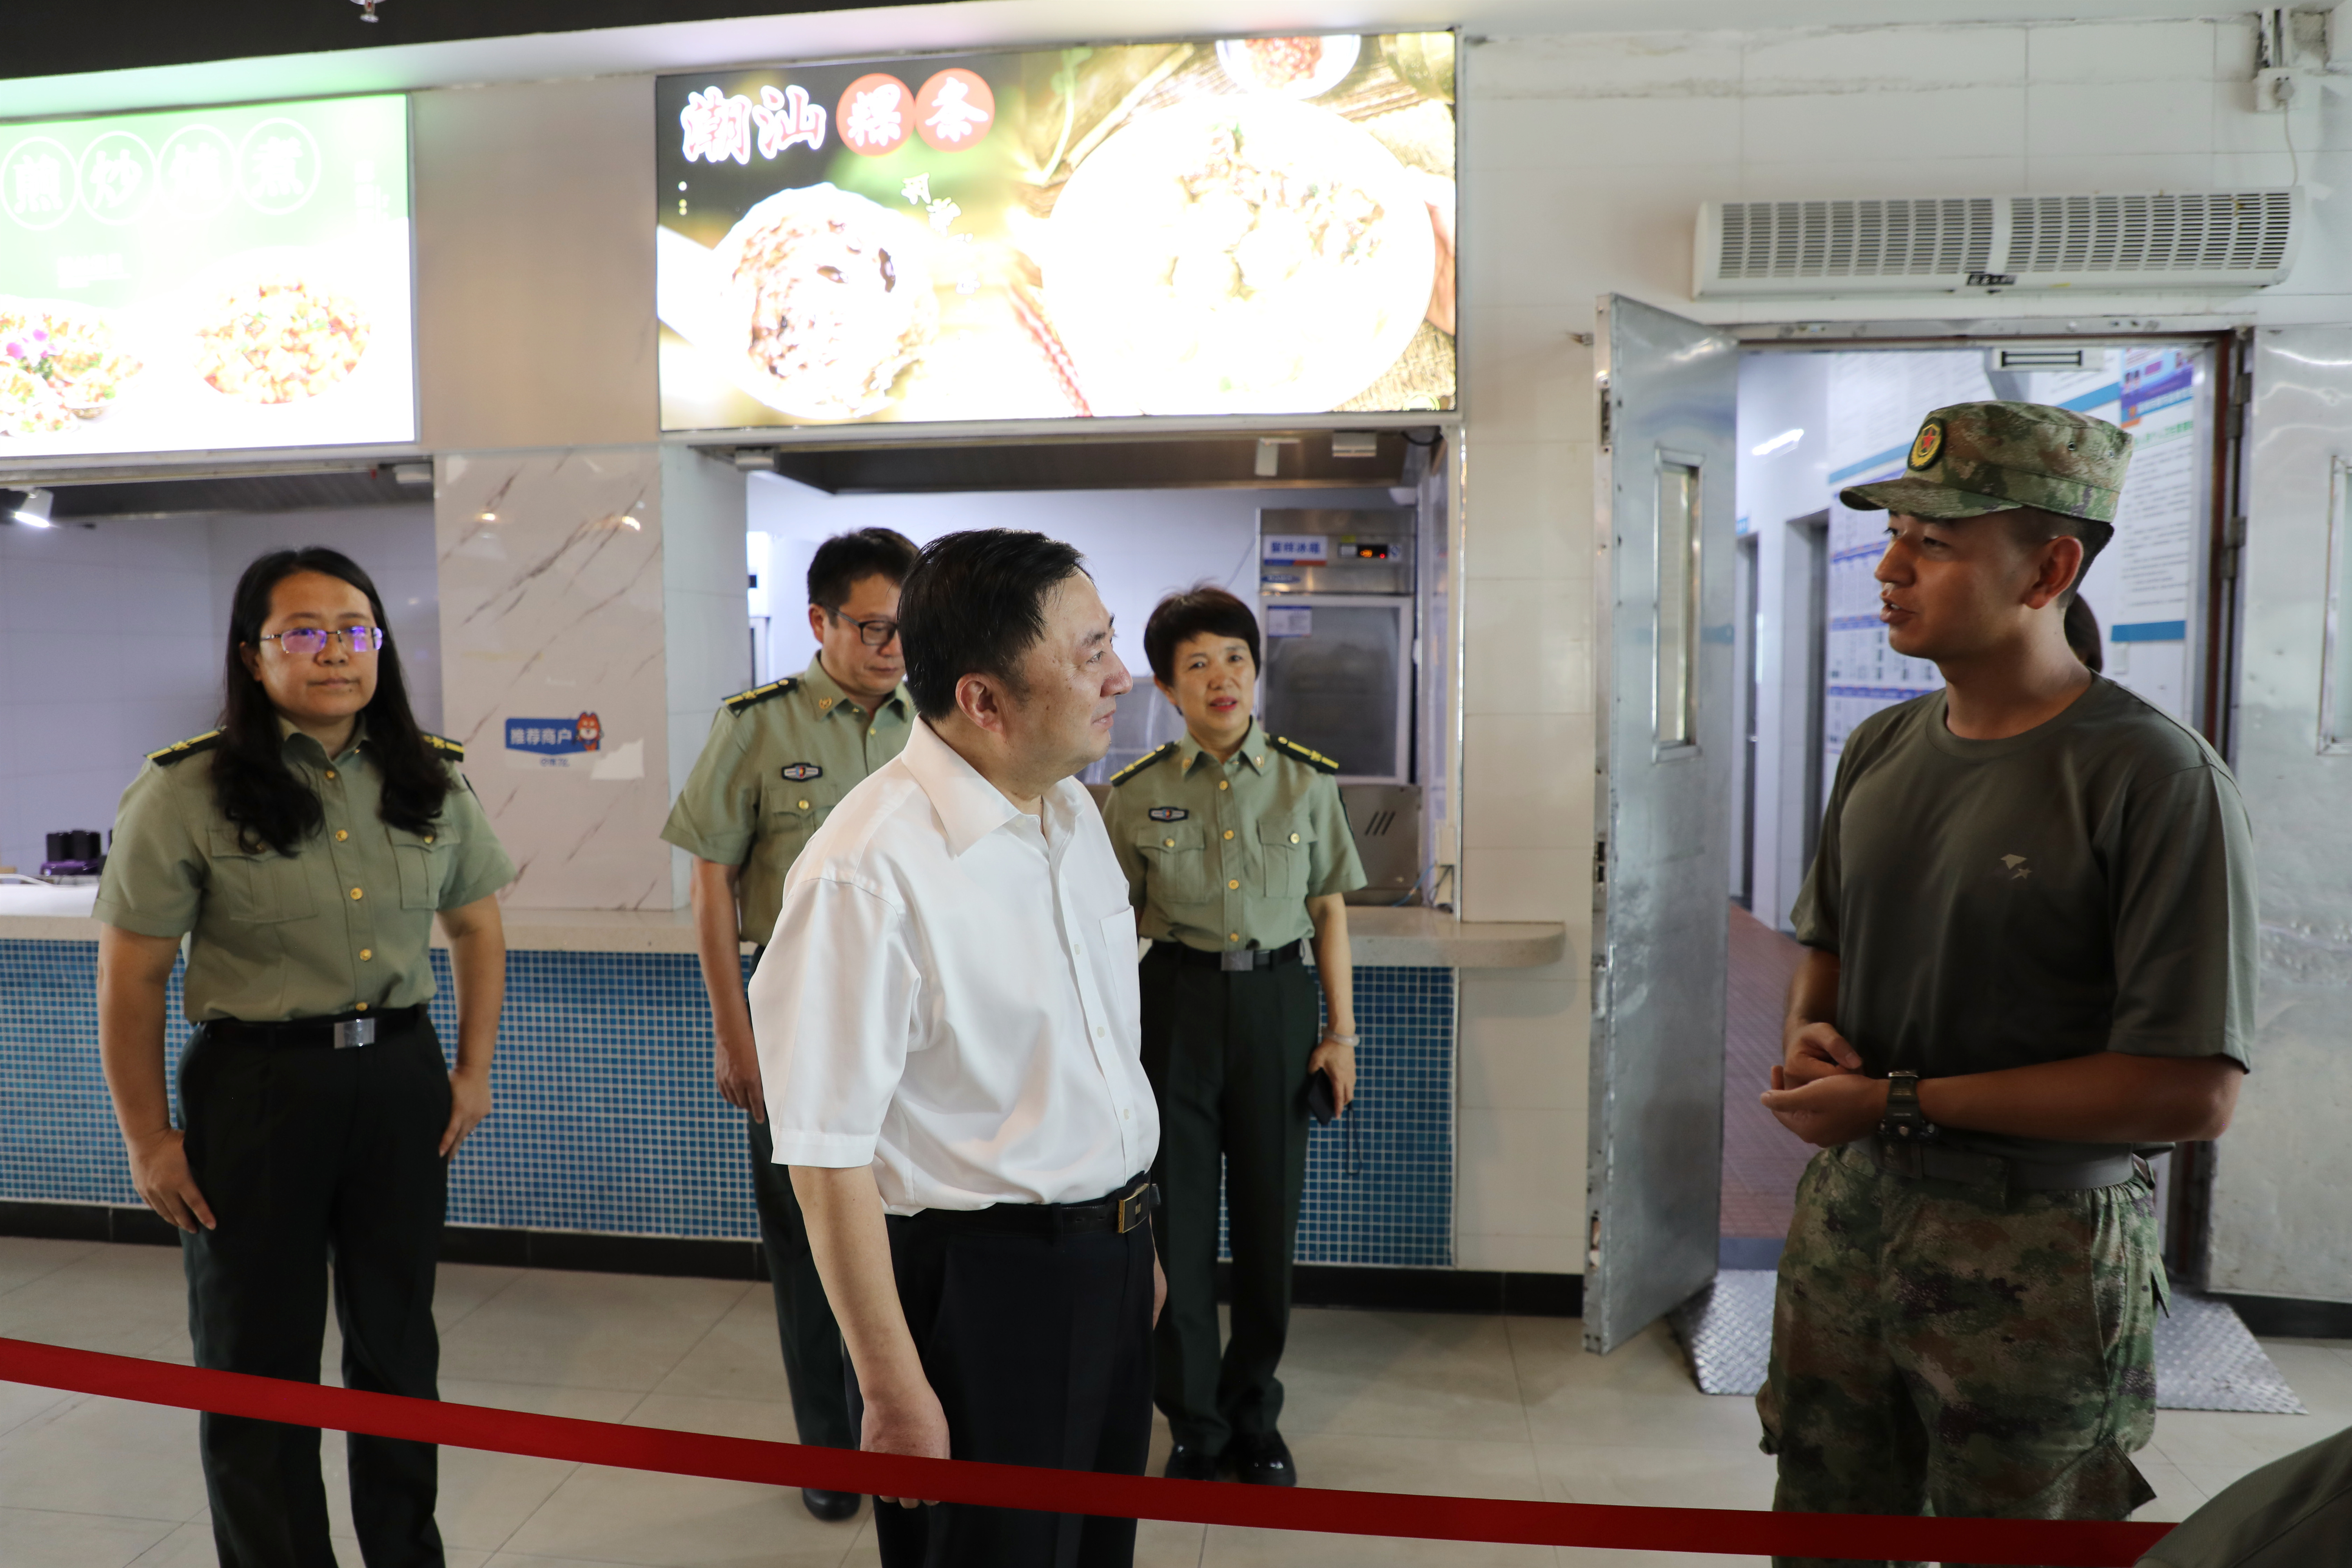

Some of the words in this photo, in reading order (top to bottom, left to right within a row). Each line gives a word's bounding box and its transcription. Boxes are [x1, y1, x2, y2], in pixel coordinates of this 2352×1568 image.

[681, 77, 988, 164] 潮汕粿条
[511, 728, 572, 745] 推荐商户
